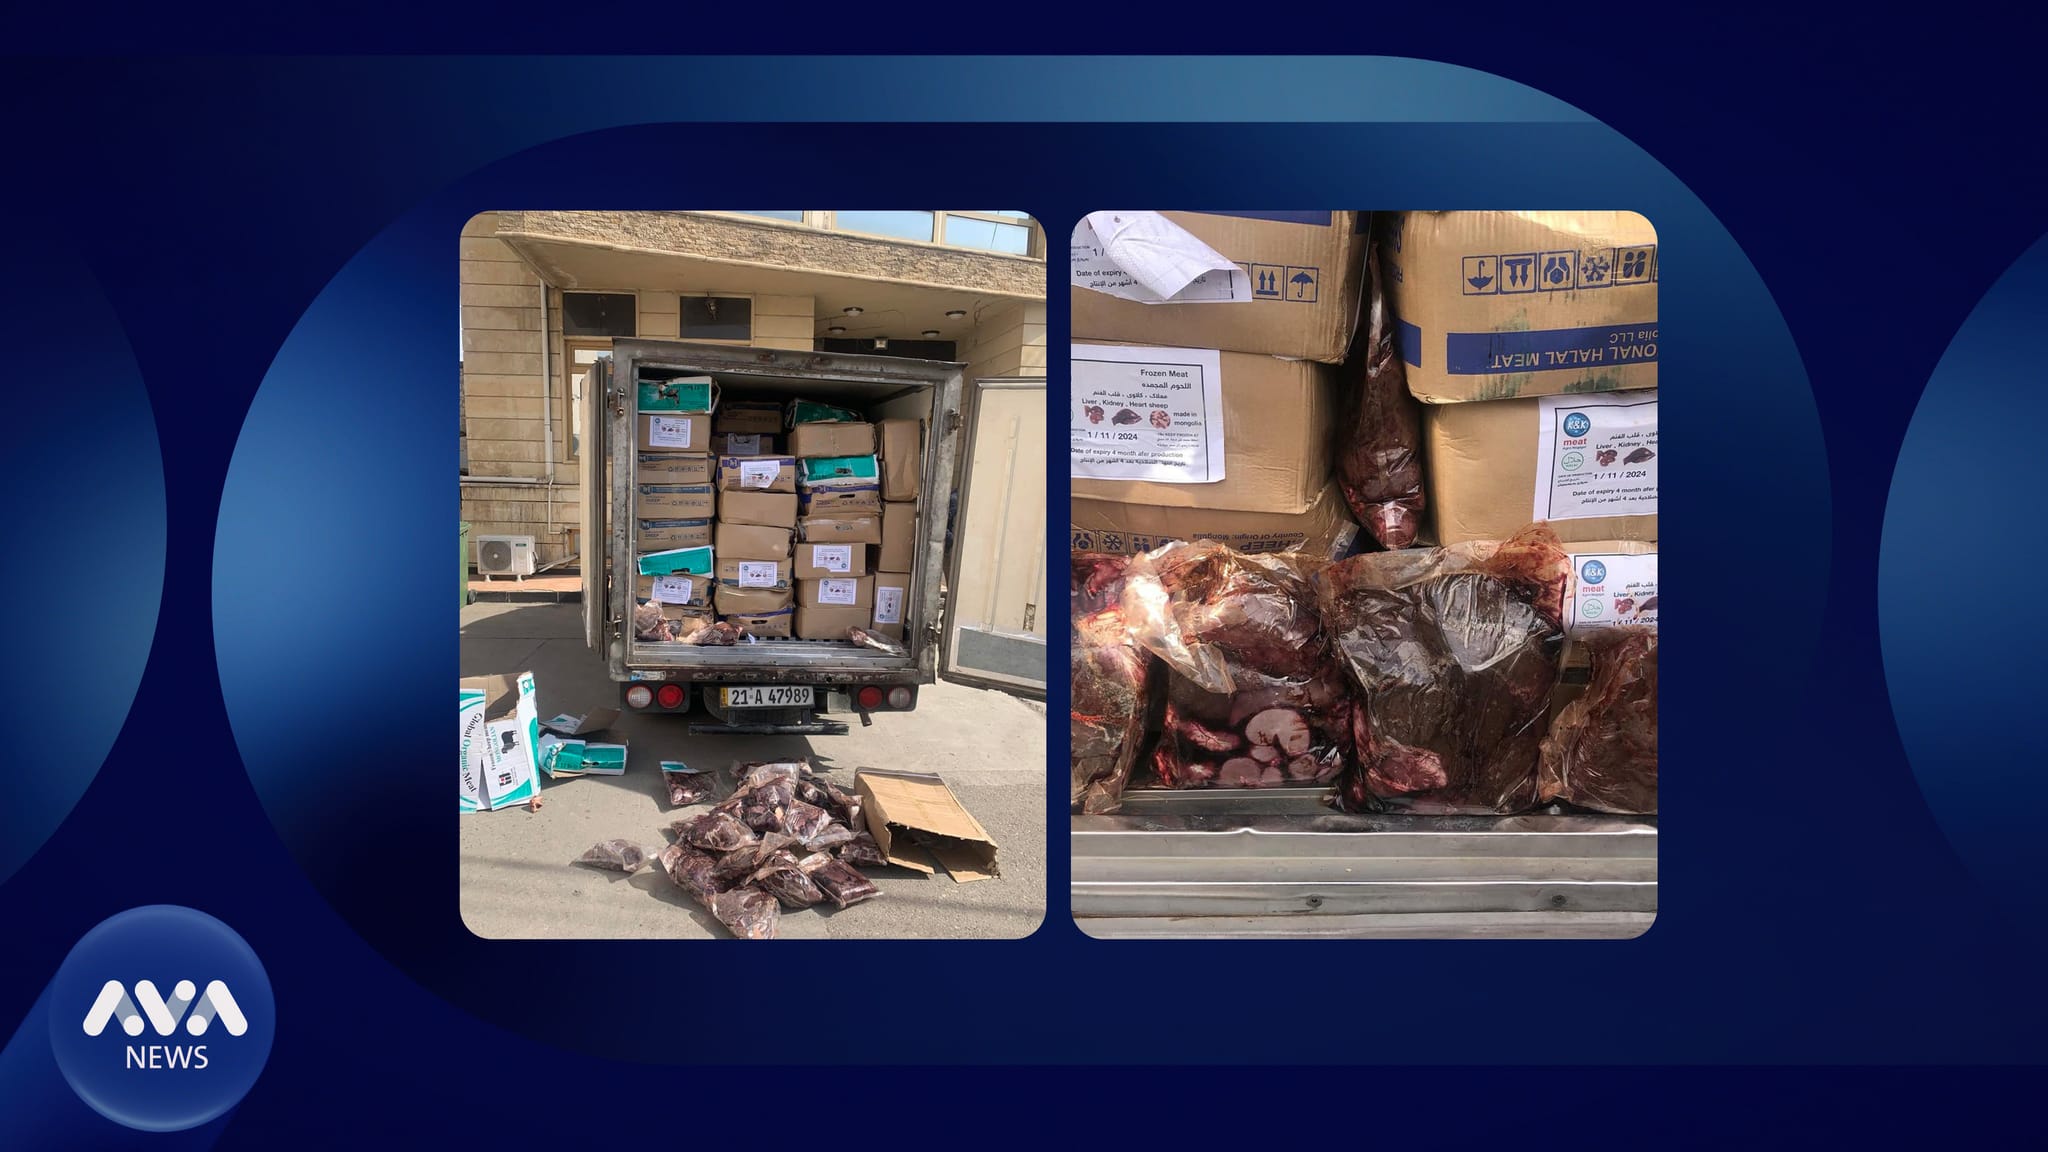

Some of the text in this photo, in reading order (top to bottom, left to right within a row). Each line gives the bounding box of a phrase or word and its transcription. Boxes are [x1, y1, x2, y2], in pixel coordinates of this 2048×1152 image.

[1610, 332, 1634, 344] LLC
[1492, 352, 1540, 369] MEAT
[1545, 349, 1603, 366] HALAL
[1140, 369, 1188, 378] Frozen Meat
[1567, 420, 1587, 429] K&K
[1563, 438, 1587, 446] meat
[1626, 470, 1647, 478] 2024
[1585, 568, 1604, 576] K&K
[732, 689, 748, 705] 21
[755, 689, 763, 704] A
[768, 688, 809, 704] 47989
[461, 712, 483, 792] Global Organic Meat
